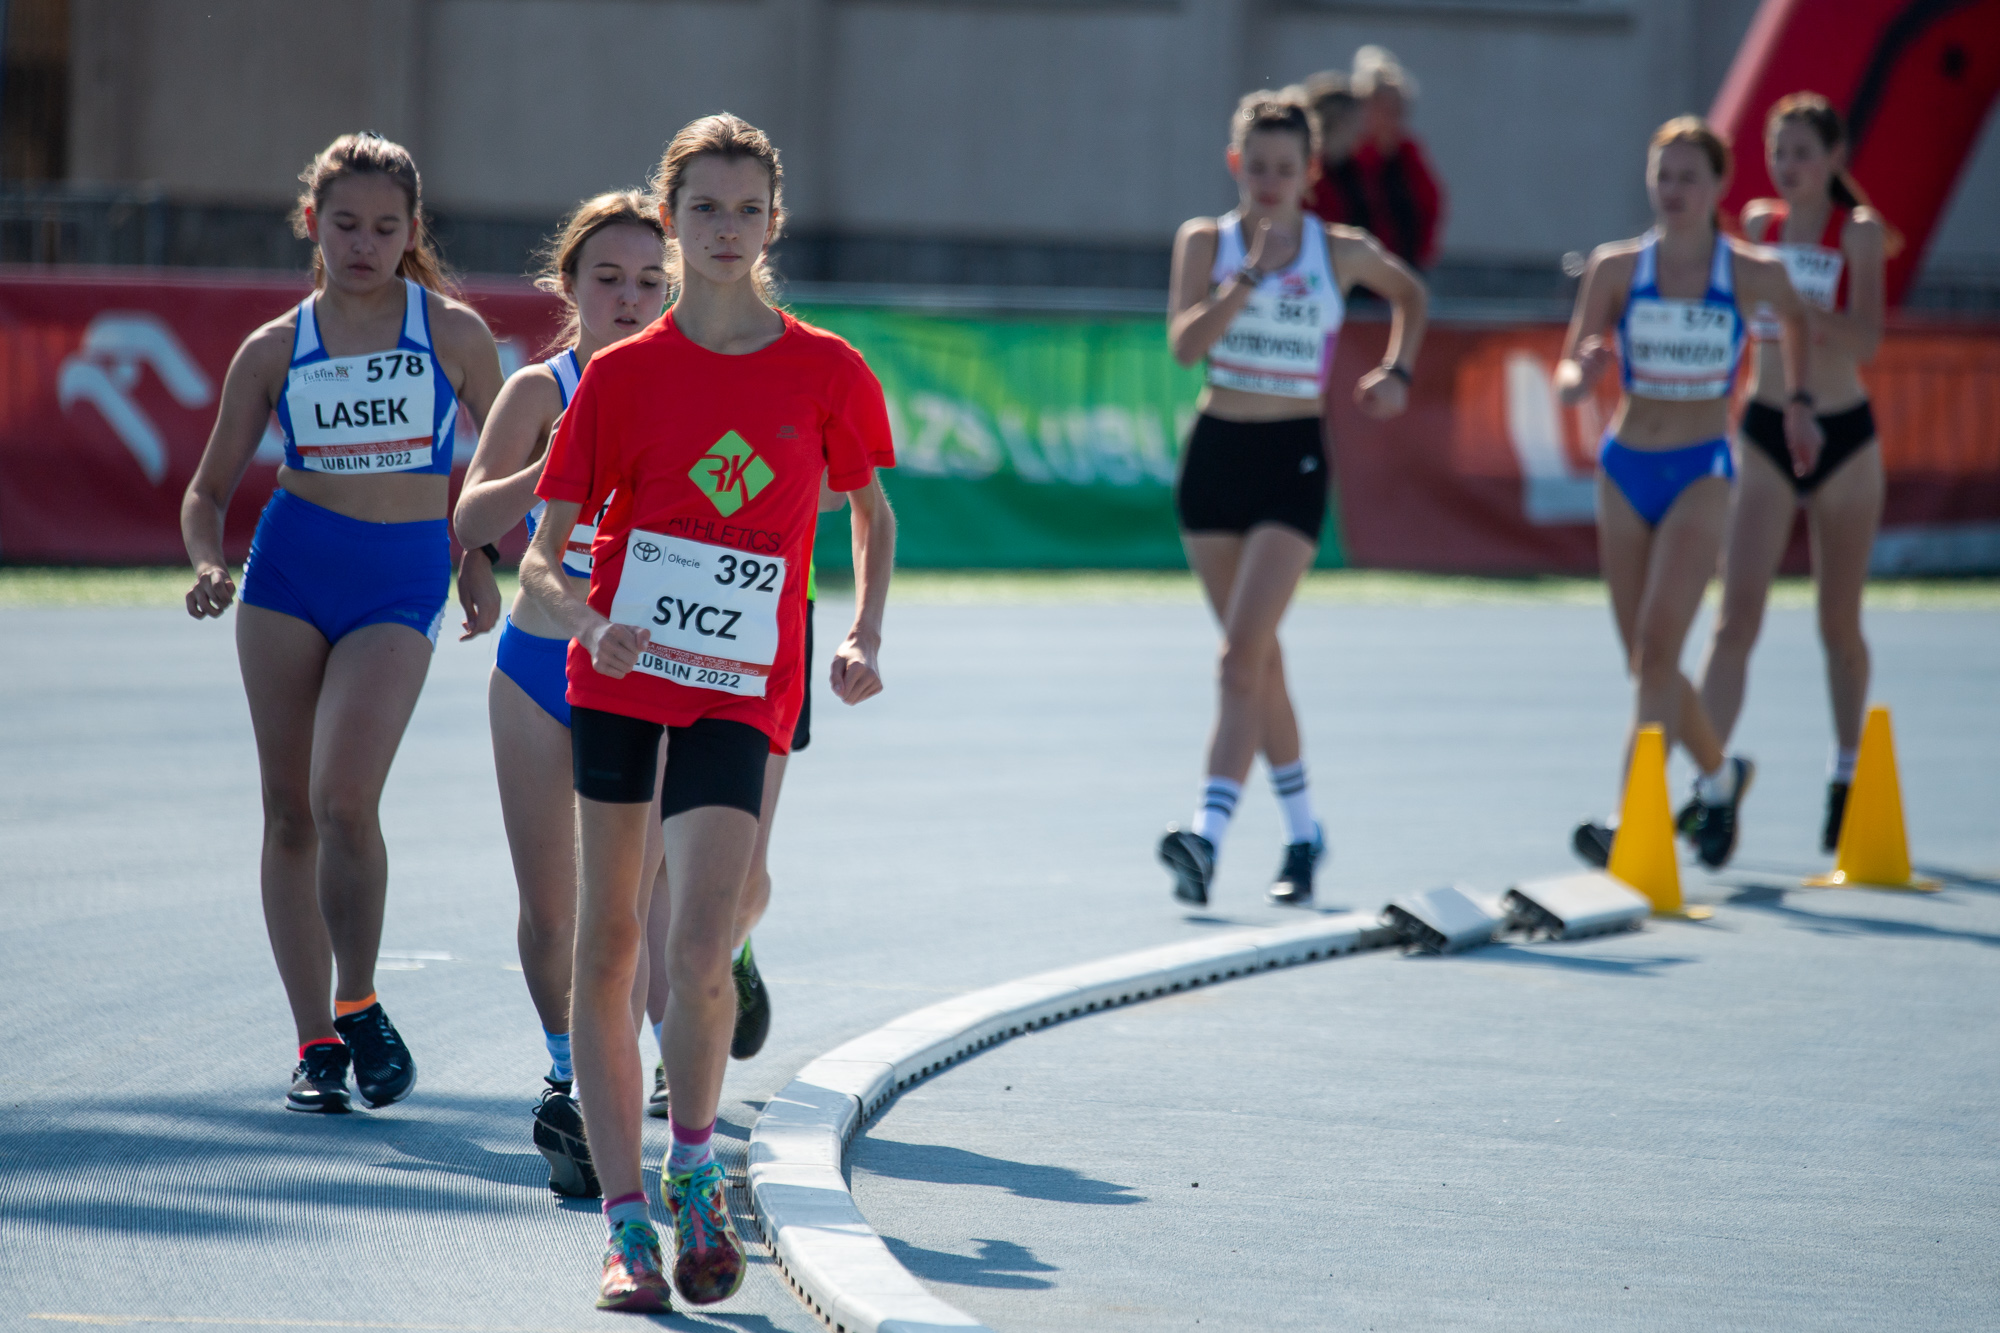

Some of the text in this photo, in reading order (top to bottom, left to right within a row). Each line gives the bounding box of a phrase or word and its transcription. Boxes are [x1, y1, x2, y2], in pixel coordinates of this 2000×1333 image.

[366, 354, 424, 383] 578
[314, 397, 409, 430] LASEK
[321, 452, 412, 470] LUBLIN 2022
[668, 517, 781, 552] ATHLETICS
[668, 554, 700, 569] Okęcie
[714, 555, 778, 593] 392
[652, 596, 742, 641] SYCZ
[634, 653, 741, 689] UBLIN 2022
